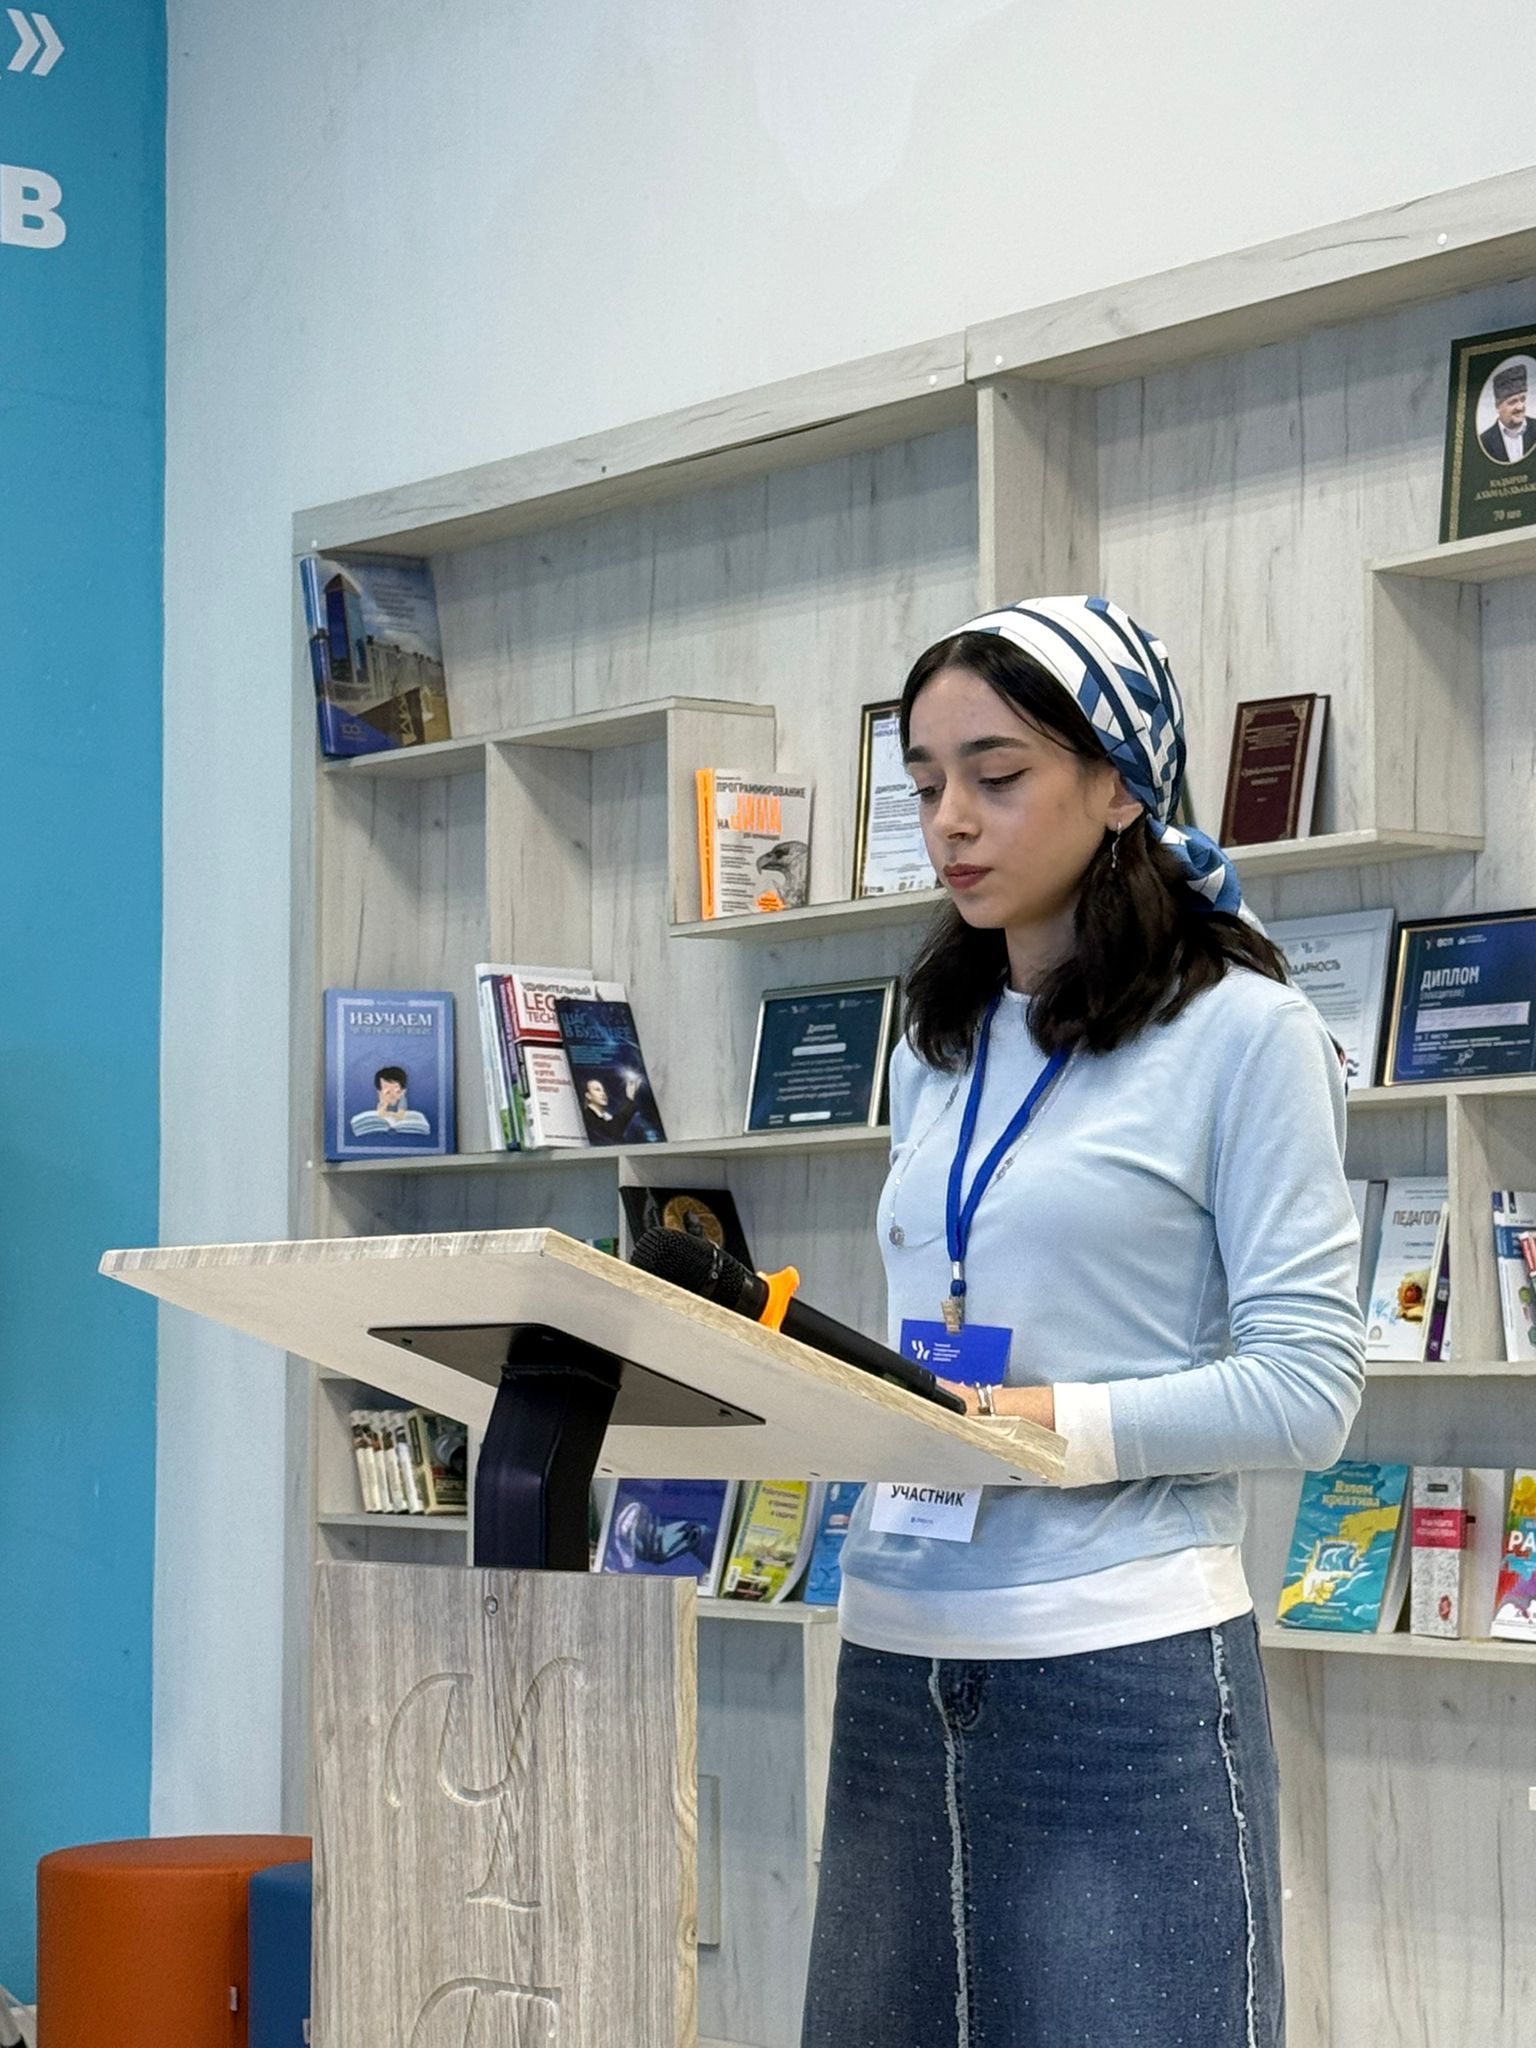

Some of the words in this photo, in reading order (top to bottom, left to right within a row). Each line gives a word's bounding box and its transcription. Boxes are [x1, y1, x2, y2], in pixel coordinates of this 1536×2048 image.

[716, 782, 806, 799] ПРОГРАММИРОВАНИЕ
[717, 819, 730, 830] НА
[1290, 959, 1342, 976] ДАРНОСТЬ
[1420, 966, 1480, 991] ДИПЛОМ
[349, 1011, 433, 1027] ИЗУЧАЕМ
[527, 1011, 556, 1025] TECH
[890, 1484, 967, 1508] УЧАСТНИК
[1333, 1480, 1374, 1496] Взлом
[1508, 1530, 1536, 1553] РА
